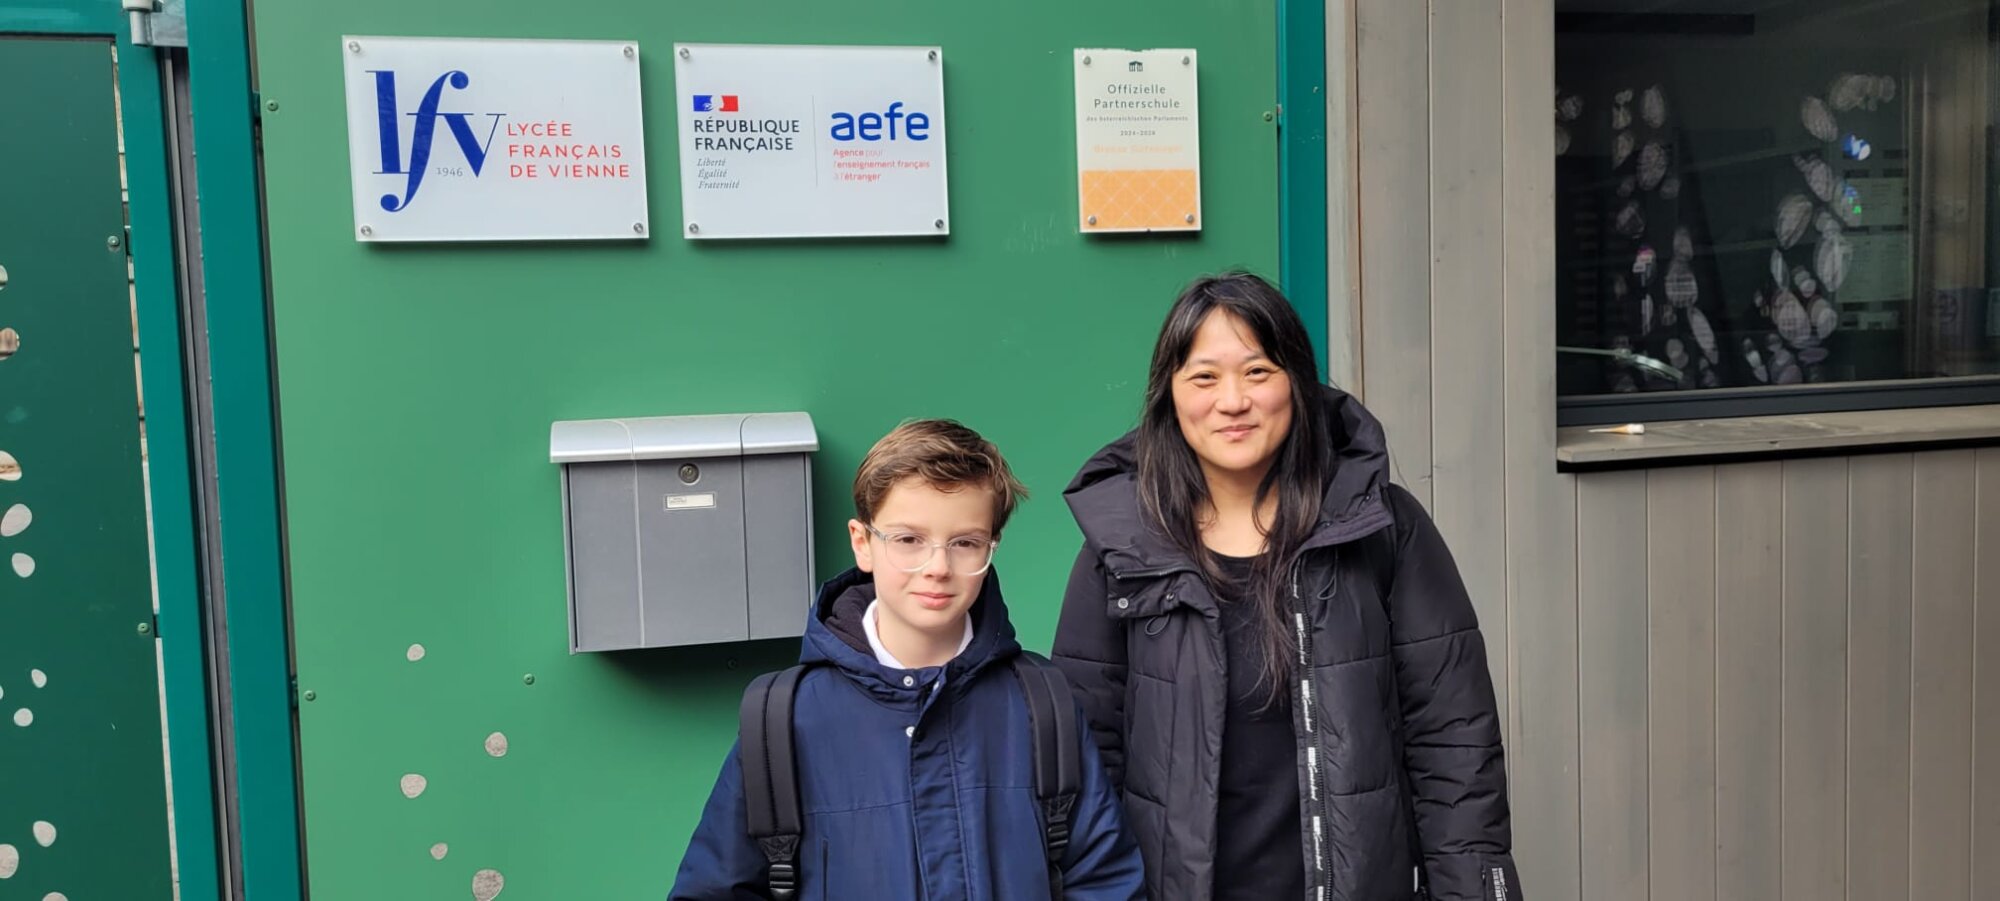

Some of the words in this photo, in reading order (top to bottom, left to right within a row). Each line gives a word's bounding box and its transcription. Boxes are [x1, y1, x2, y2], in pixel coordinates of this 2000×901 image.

[1107, 84, 1166, 94] Offizielle
[1094, 98, 1181, 108] Partnerschule
[694, 116, 800, 135] RÉPUBLIQUE
[831, 102, 930, 141] aefe
[507, 120, 573, 137] LYCÉE
[695, 137, 793, 153] FRANÇAISE
[508, 144, 622, 160] FRANÇAIS
[833, 148, 864, 158] Agence
[697, 158, 726, 167] Liberté
[833, 160, 895, 169] l'enseignement
[897, 160, 930, 169] français
[436, 166, 464, 177] 1946
[510, 164, 537, 178] DE
[548, 164, 630, 178] VIENNE
[698, 168, 728, 180] Égalité
[698, 180, 741, 189] Fraternité
